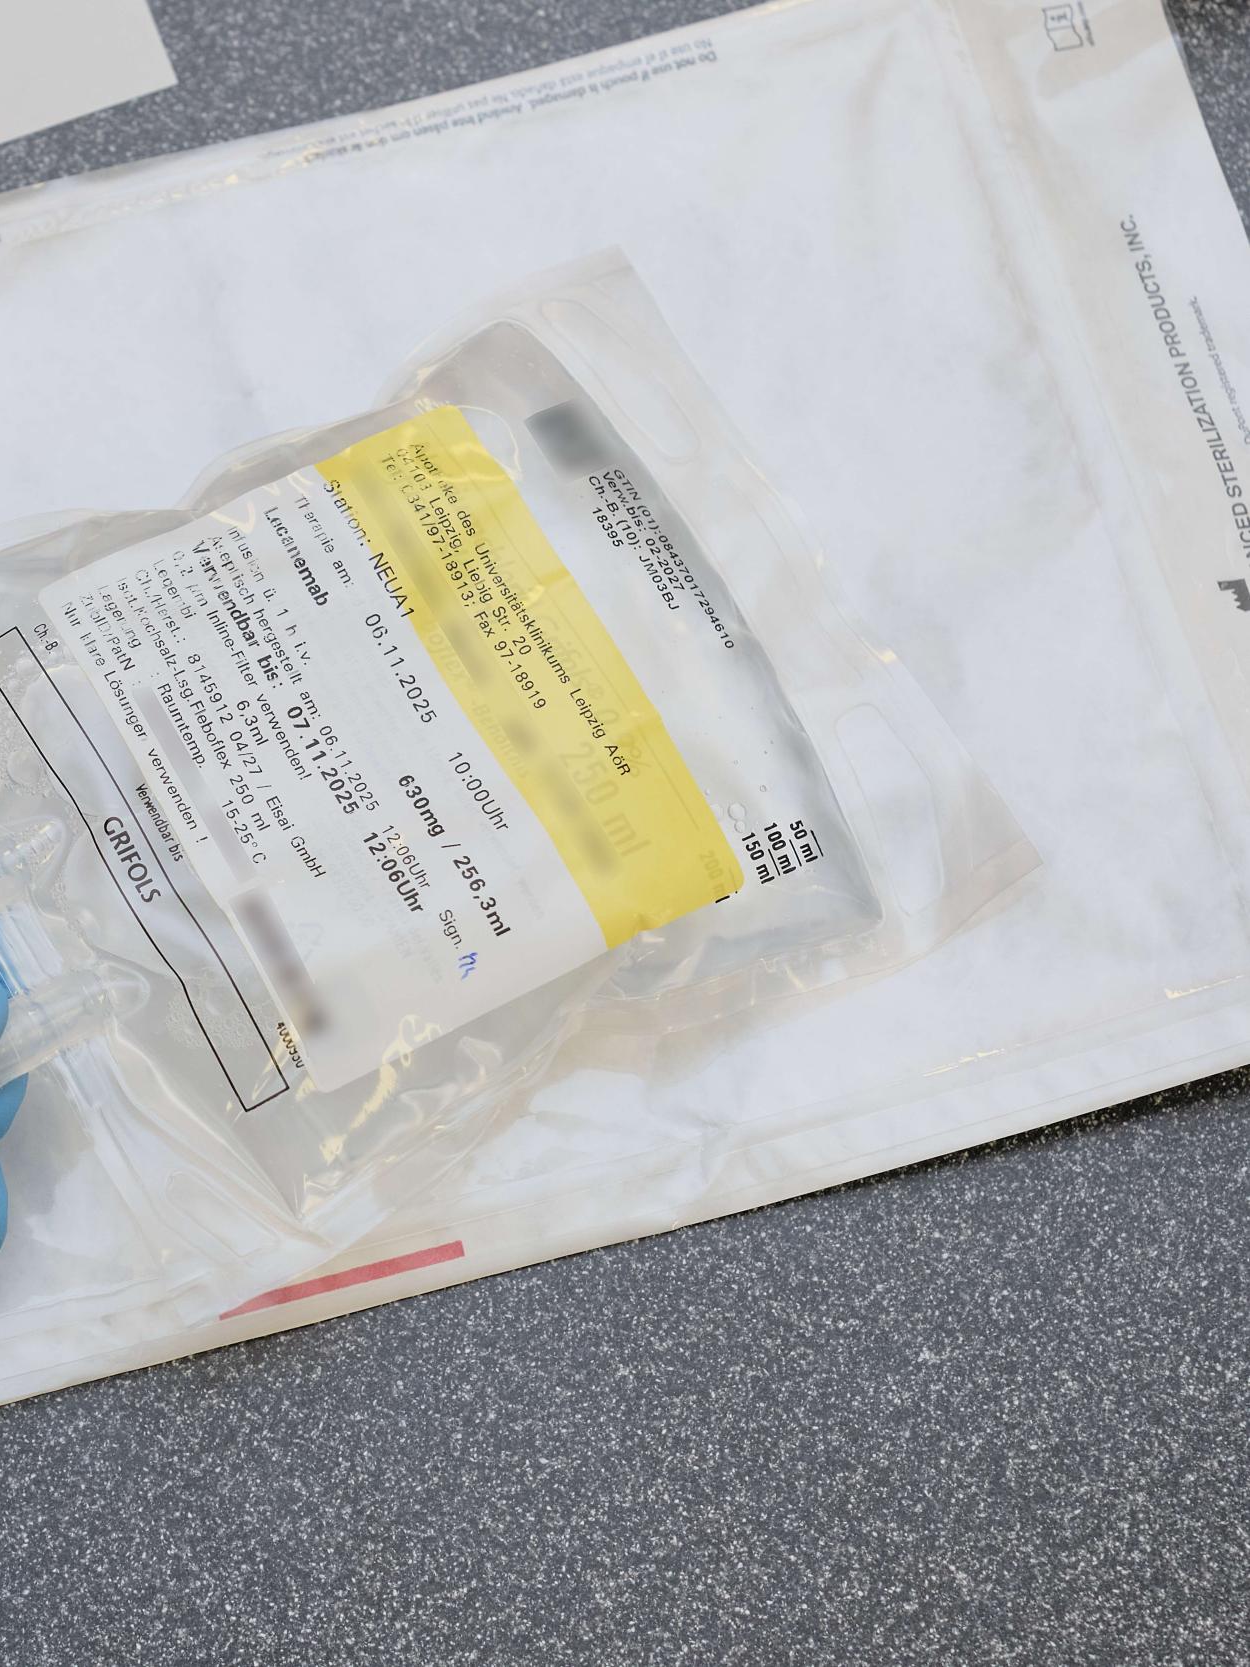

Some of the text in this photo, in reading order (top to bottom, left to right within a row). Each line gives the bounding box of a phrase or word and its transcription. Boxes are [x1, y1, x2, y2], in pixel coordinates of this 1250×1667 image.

[1120, 214, 1145, 252] INC.
[1135, 254, 1187, 358] PRODUCTS,
[1174, 362, 1243, 498] STERILIZATION
[593, 507, 624, 547] 18395
[603, 470, 685, 590] Verw.bis: 02-2027
[613, 469, 642, 502] GTIN
[323, 480, 414, 618] Station: NEUA1
[425, 497, 463, 553] Leipzig,
[457, 559, 493, 604] Liebig
[492, 606, 511, 631] Str.
[512, 636, 532, 655] 20
[589, 476, 680, 610] Ch.-B. (10): JM03BJ
[34, 623, 58, 654] Ch.-B.
[263, 588, 276, 602] ü.
[285, 624, 297, 636] h
[294, 641, 310, 665] i.v.
[409, 444, 460, 510] Apoteke
[457, 511, 476, 536] des
[475, 542, 570, 684] Universitätsklinikums
[569, 688, 606, 739] Leipzig
[604, 745, 630, 775] AöR
[207, 610, 257, 685] Inline-Filter
[257, 693, 312, 780] verwenden!
[333, 560, 353, 587] am:
[365, 614, 437, 723] 06.11.2025
[449, 752, 509, 829] 10:00Uhr
[474, 611, 495, 637] Fax
[494, 641, 546, 709] 97-18919
[158, 683, 205, 768] Raumtemp.
[188, 654, 233, 724] 8145912
[229, 731, 263, 774] 04/27
[266, 796, 294, 831] Eisai
[291, 836, 326, 877] GmbH
[192, 541, 423, 912] Verwendbar bis: 07.11.2025 12:06Uhr
[236, 700, 269, 746] 6,3ml
[265, 507, 329, 606] Lecanemab
[399, 775, 445, 837] 630mg
[453, 856, 511, 937] 256,3ml
[135, 783, 185, 862] Verwendbar bis
[148, 748, 197, 830] verwenden
[230, 774, 254, 804] 250
[251, 813, 270, 831] ml
[248, 608, 303, 685] hergestellt
[299, 691, 320, 719] am:
[319, 726, 380, 811] 06.11.2025
[383, 825, 429, 895] 12:06Uhr
[439, 909, 462, 949] Sign.
[103, 816, 161, 903] GRIFOLS
[742, 832, 775, 884] 150 ml
[764, 822, 796, 875] 100 ml
[789, 820, 818, 863] 50 ml
